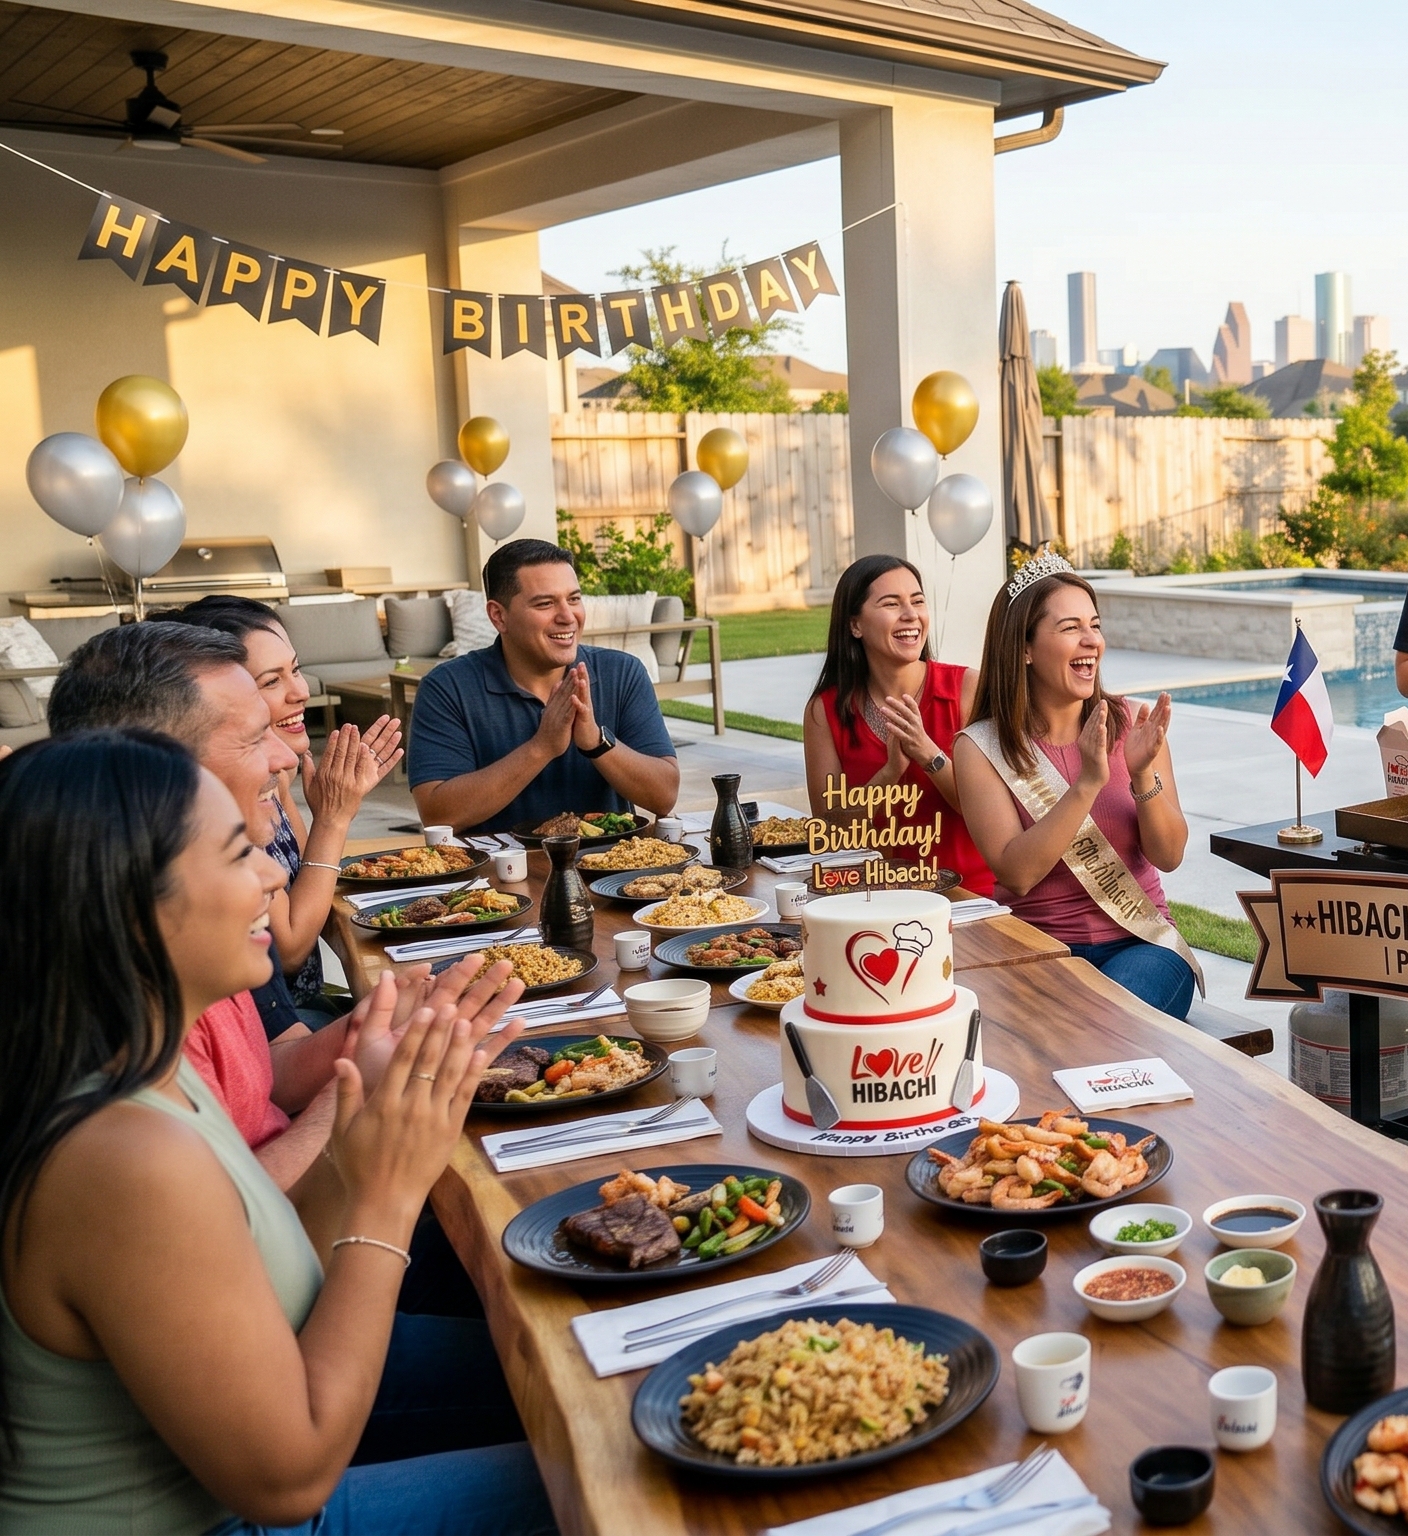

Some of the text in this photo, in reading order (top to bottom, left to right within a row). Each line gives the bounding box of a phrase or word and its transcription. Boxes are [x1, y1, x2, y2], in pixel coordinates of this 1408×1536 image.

[96, 204, 837, 343] HAPPY BIRTHDAY
[822, 773, 924, 819] Happy
[804, 811, 942, 857] Birthday!
[852, 1074, 936, 1103] HIBACHI
